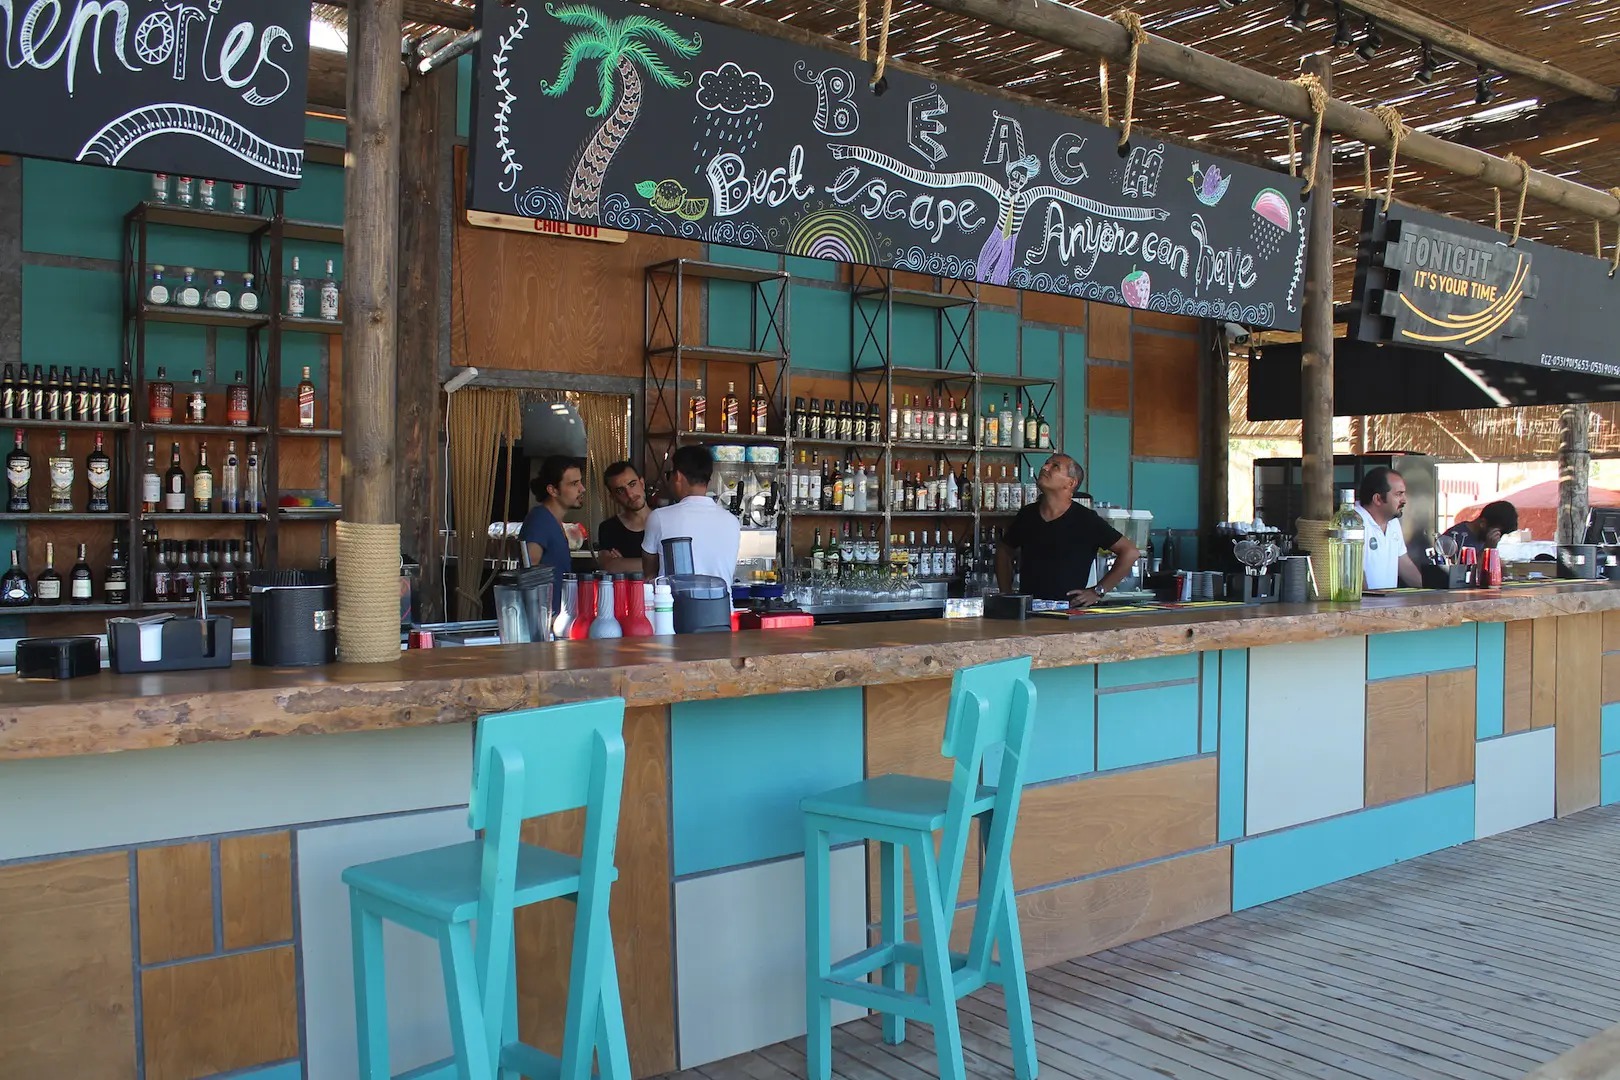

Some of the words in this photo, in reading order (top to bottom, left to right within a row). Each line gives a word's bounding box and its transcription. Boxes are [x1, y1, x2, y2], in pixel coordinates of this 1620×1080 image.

[574, 224, 599, 238] OUT
[706, 144, 815, 217] Best
[825, 166, 986, 244] escape
[1024, 200, 1139, 280] Anyone
[1142, 231, 1190, 279] can
[1191, 213, 1257, 298] have
[1404, 232, 1493, 280] TONIGHT
[1414, 270, 1438, 290] IT'S
[1439, 275, 1469, 297] YOUR
[1471, 281, 1498, 302] TIME
